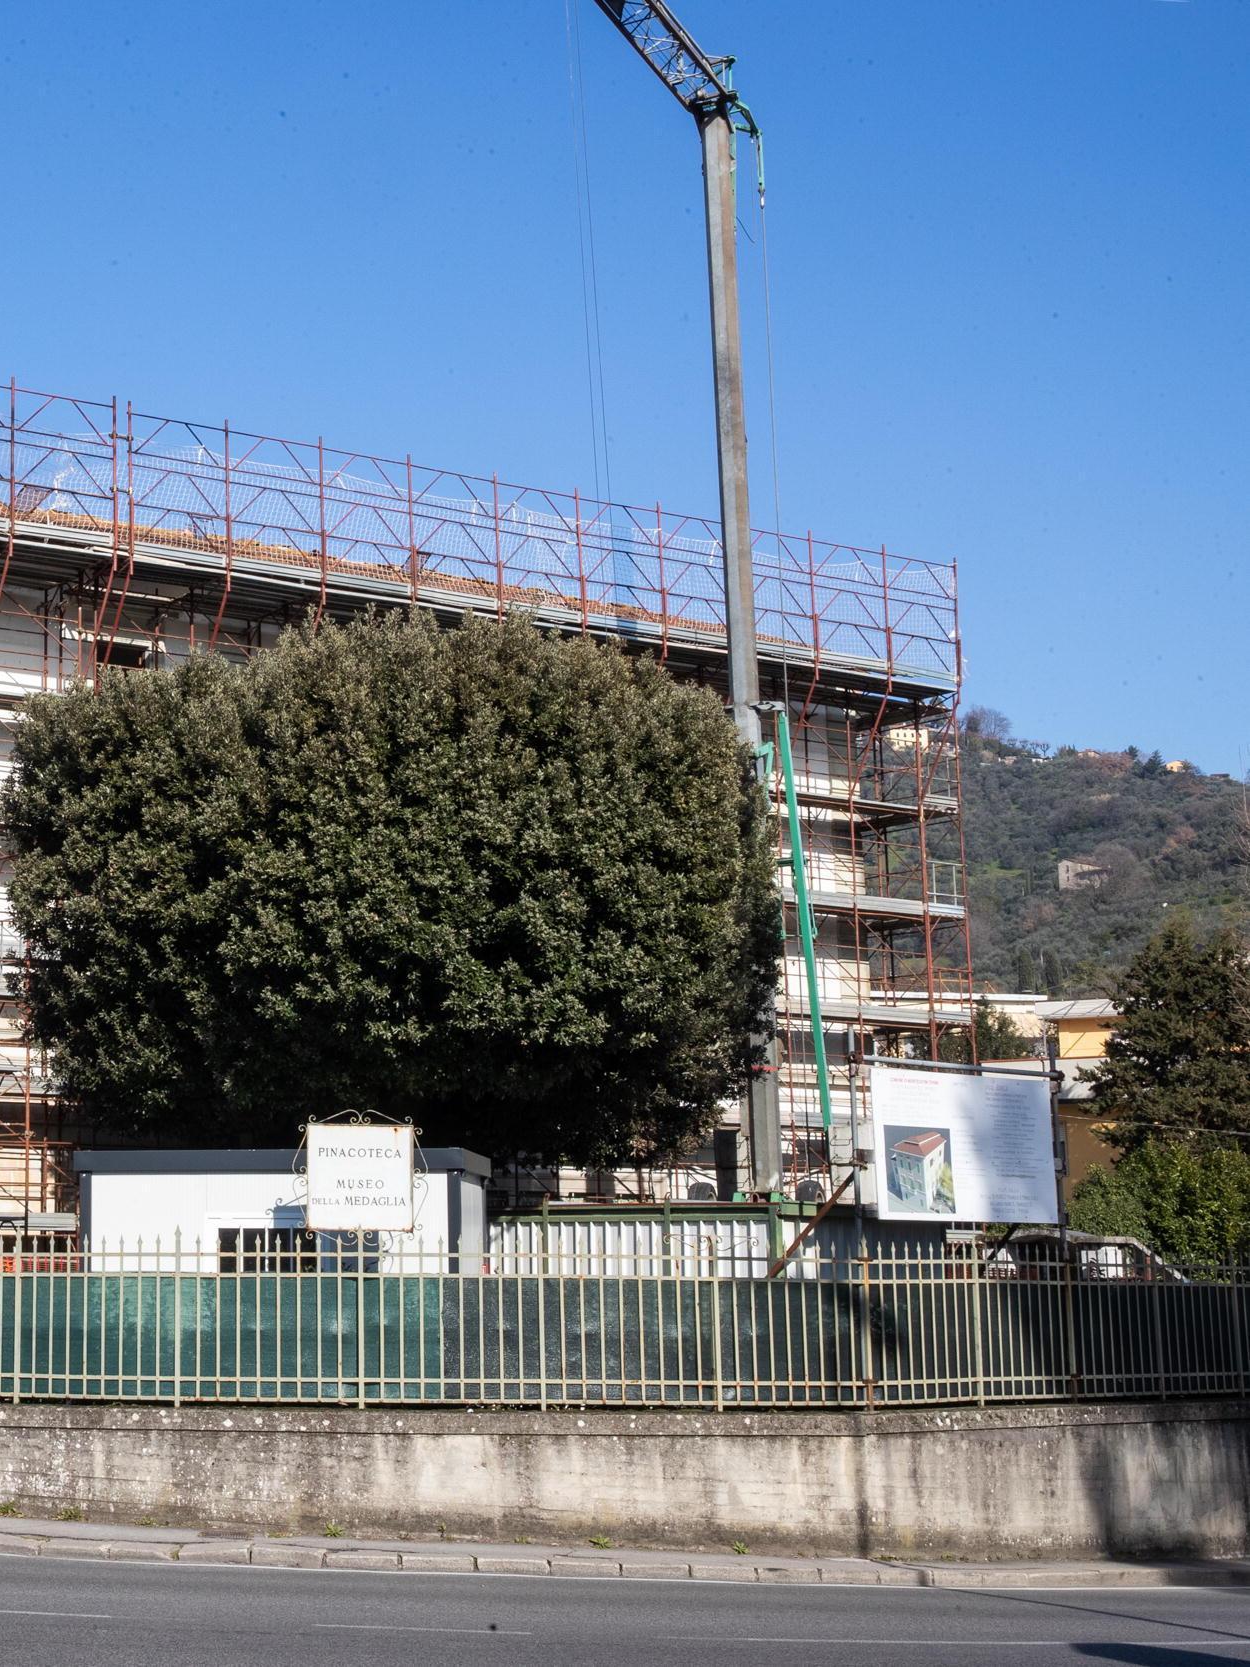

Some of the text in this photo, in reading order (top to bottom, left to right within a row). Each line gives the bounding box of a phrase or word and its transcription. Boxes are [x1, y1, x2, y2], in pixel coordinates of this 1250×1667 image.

[318, 1147, 402, 1159] PINACOTECA
[336, 1179, 384, 1190] MUSEO
[311, 1195, 406, 1207] DELLA MEDAGLIA
